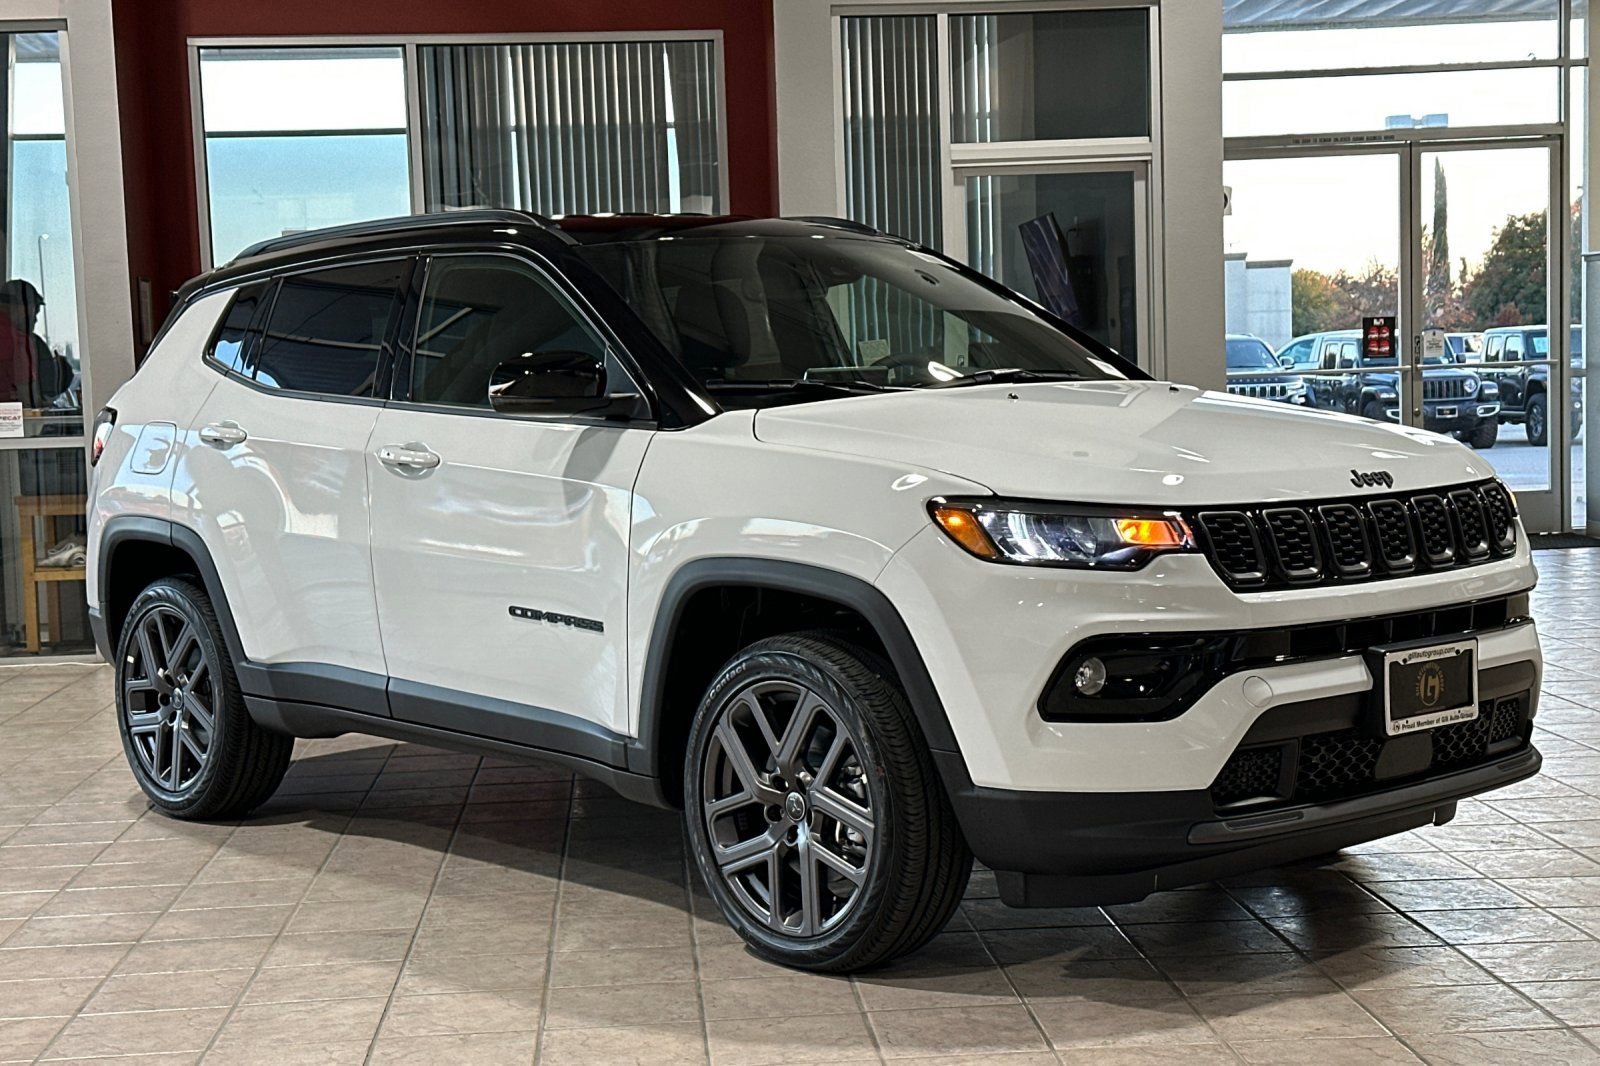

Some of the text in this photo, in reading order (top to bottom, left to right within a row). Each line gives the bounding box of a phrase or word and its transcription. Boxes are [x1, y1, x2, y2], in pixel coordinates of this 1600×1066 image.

[1350, 469, 1394, 489] Jeep
[508, 605, 604, 633] COMPASS
[1417, 719, 1435, 727] Member
